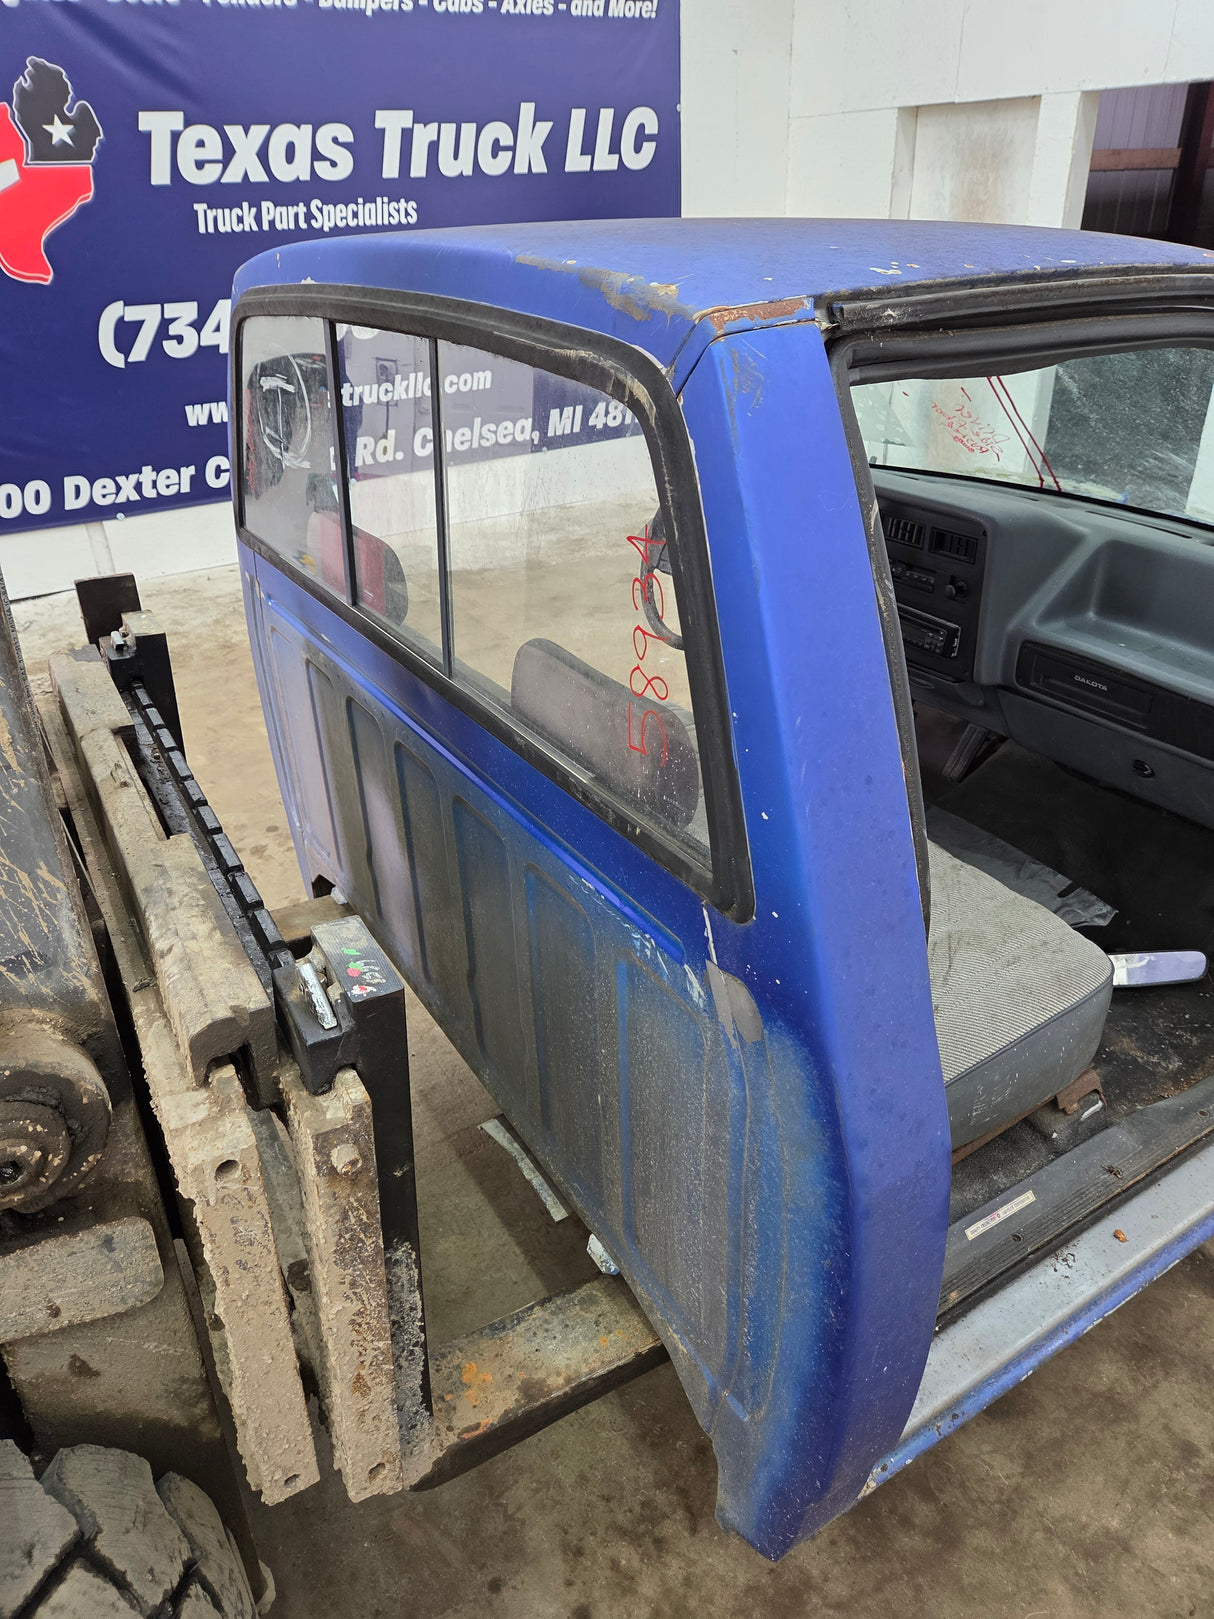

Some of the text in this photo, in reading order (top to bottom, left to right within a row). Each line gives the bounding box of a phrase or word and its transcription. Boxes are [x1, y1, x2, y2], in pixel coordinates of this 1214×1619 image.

[500, 0, 554, 15] Axles
[607, 0, 658, 19] More!
[138, 102, 659, 186] Texas Truck LLC
[193, 197, 418, 234] Truck Part Specialists
[355, 429, 404, 467] Rd.
[547, 404, 583, 438] MI
[588, 400, 640, 429] 481
[64, 465, 196, 510] Dexter
[626, 523, 669, 768] 58934
[1073, 674, 1108, 691] DAKOTA
